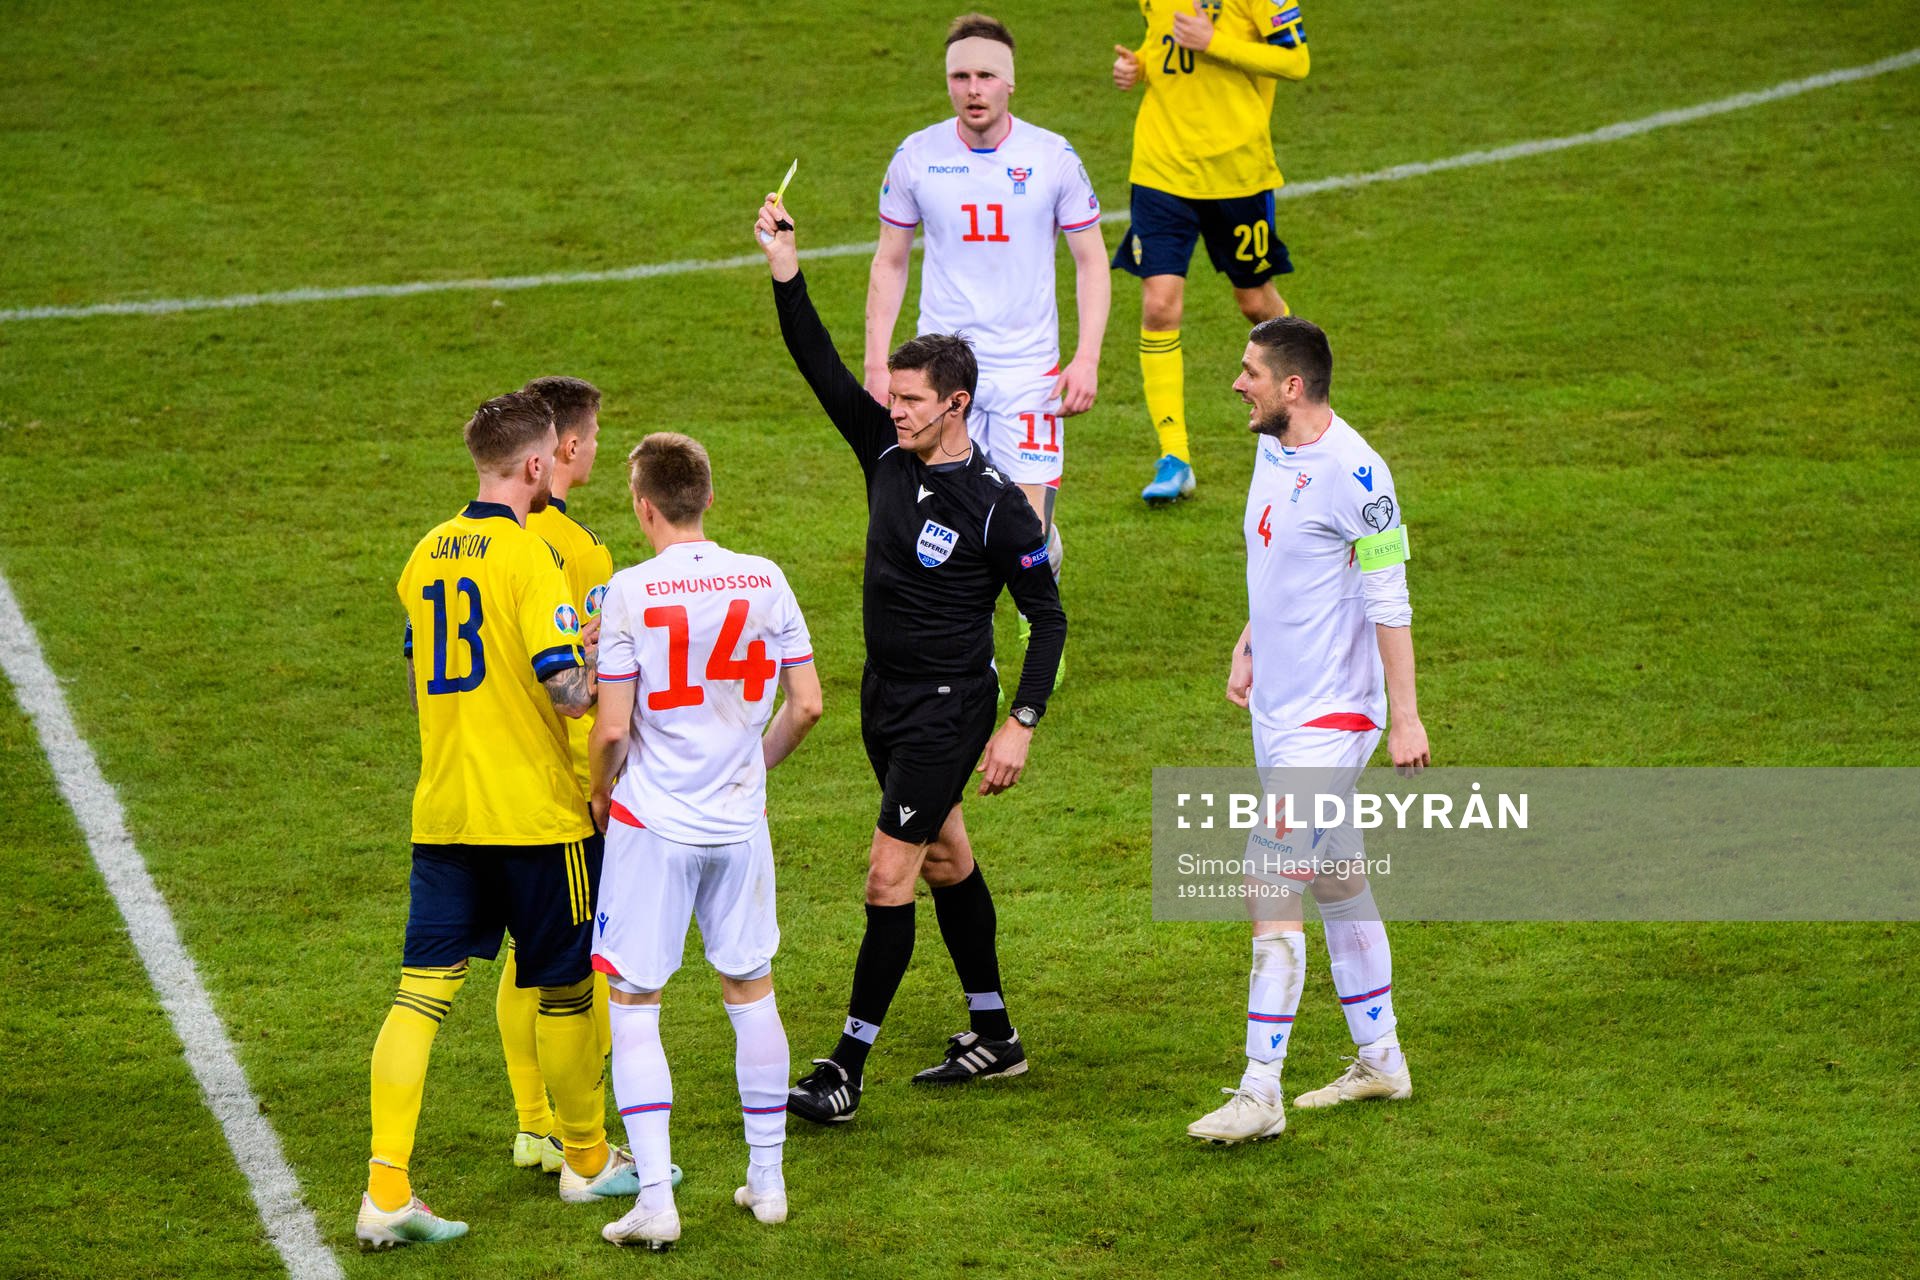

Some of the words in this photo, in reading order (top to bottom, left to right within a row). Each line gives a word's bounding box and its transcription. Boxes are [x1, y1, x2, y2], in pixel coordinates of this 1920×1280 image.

[1162, 34, 1195, 74] 20
[928, 165, 970, 175] macron
[961, 204, 1010, 242] 11
[1233, 219, 1269, 261] 20
[1018, 413, 1060, 453] 11
[925, 523, 953, 544] FIFA
[1257, 504, 1272, 548] 4
[920, 539, 949, 556] REFEREE
[645, 574, 772, 596] EDMUNDSSON
[422, 576, 487, 695] 13
[643, 599, 777, 711] 14
[1251, 834, 1294, 855] macron
